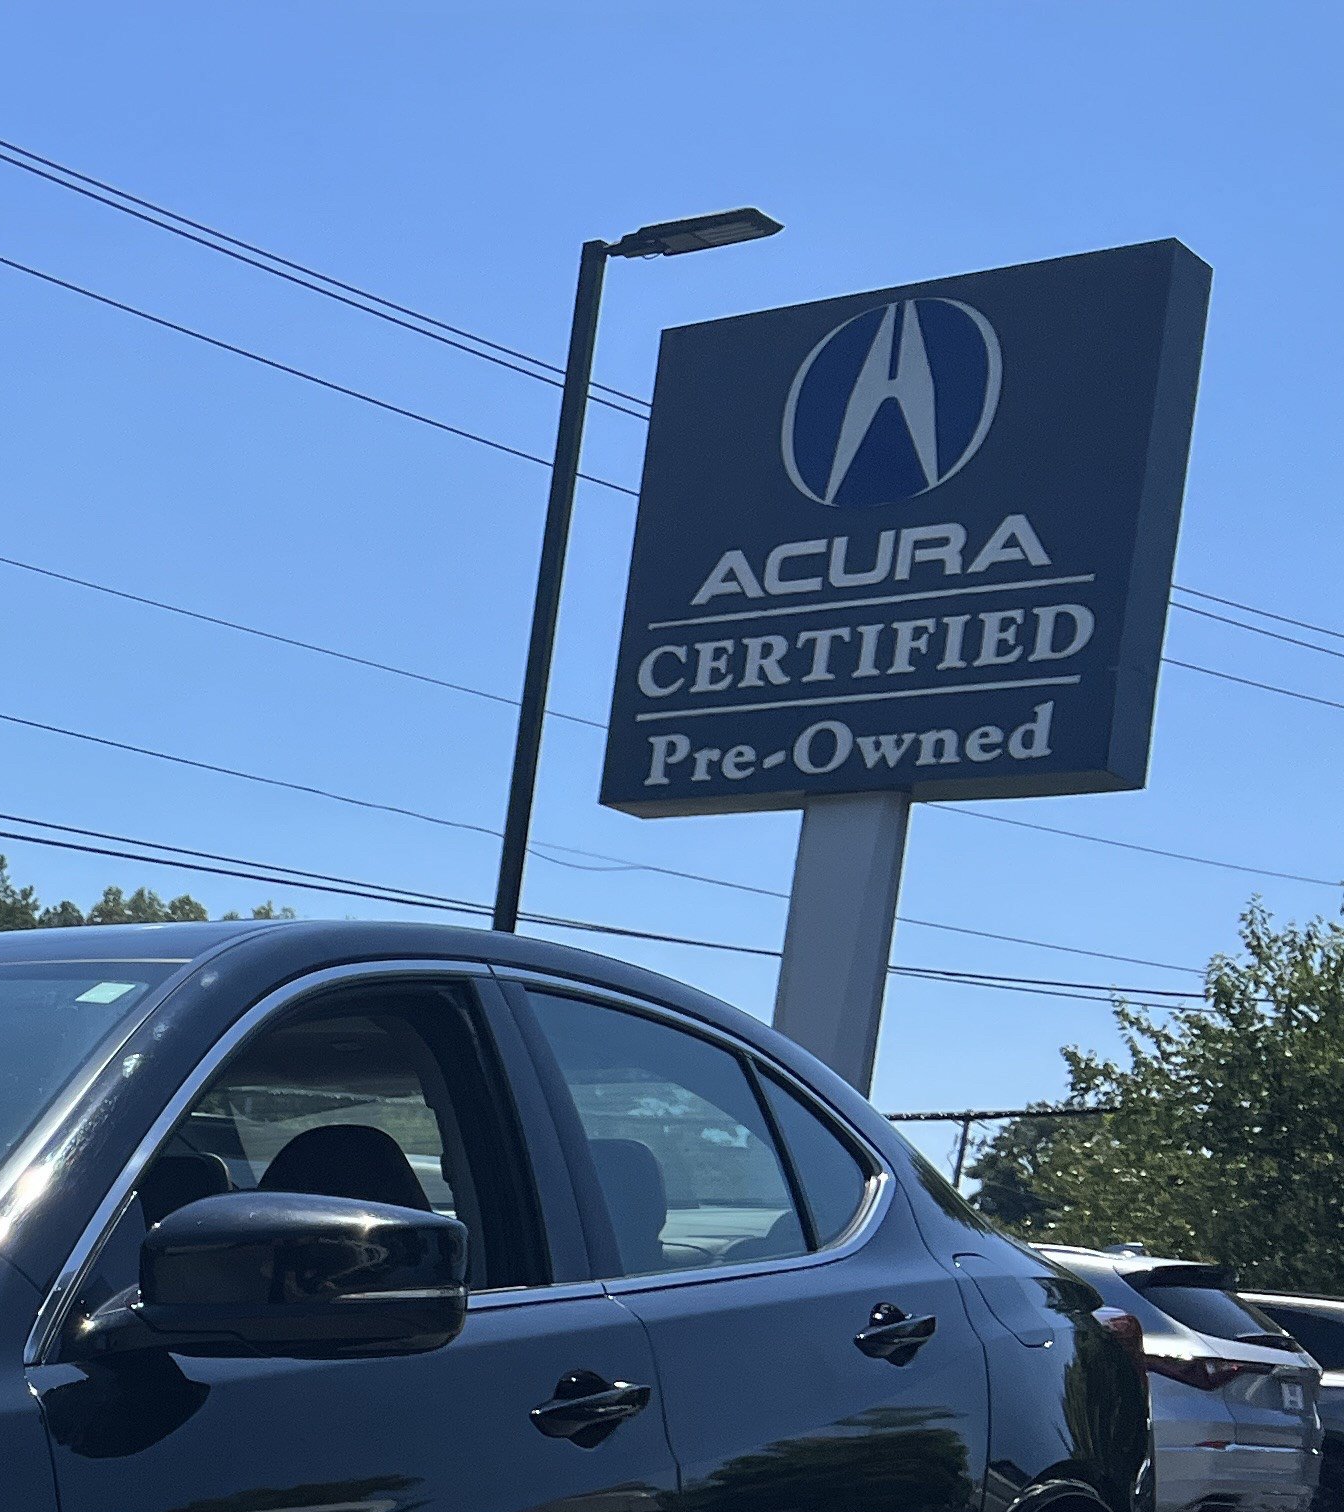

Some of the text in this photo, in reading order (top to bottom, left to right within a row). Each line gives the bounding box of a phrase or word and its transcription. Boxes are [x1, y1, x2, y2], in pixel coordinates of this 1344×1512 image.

[689, 513, 1052, 606] ACURA
[635, 603, 1096, 699] CERTIFIED
[642, 700, 1056, 787] Pre-Owned
